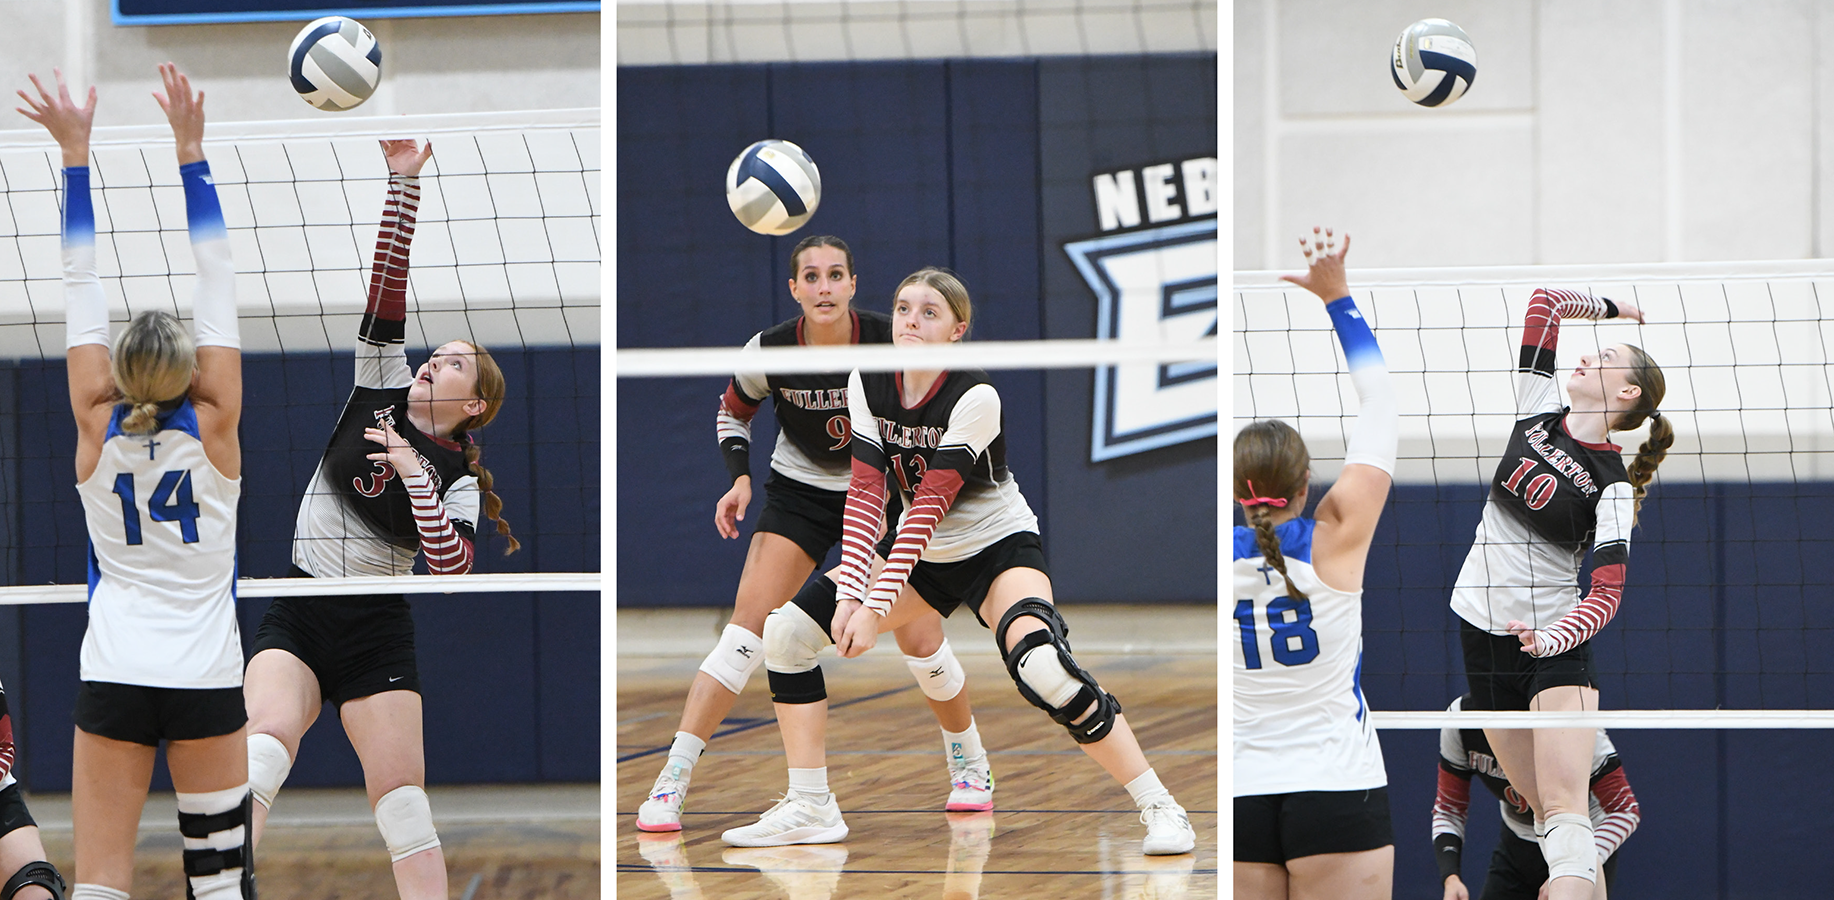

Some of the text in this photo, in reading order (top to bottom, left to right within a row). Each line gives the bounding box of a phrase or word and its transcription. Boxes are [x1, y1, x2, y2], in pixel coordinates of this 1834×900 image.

[1093, 157, 1217, 232] NEB
[826, 414, 852, 451] 9
[353, 461, 396, 498] 3
[891, 453, 928, 494] 13
[1501, 457, 1558, 510] 10
[112, 469, 200, 546] 14
[1233, 595, 1320, 670] 18
[1504, 786, 1529, 813] 9
